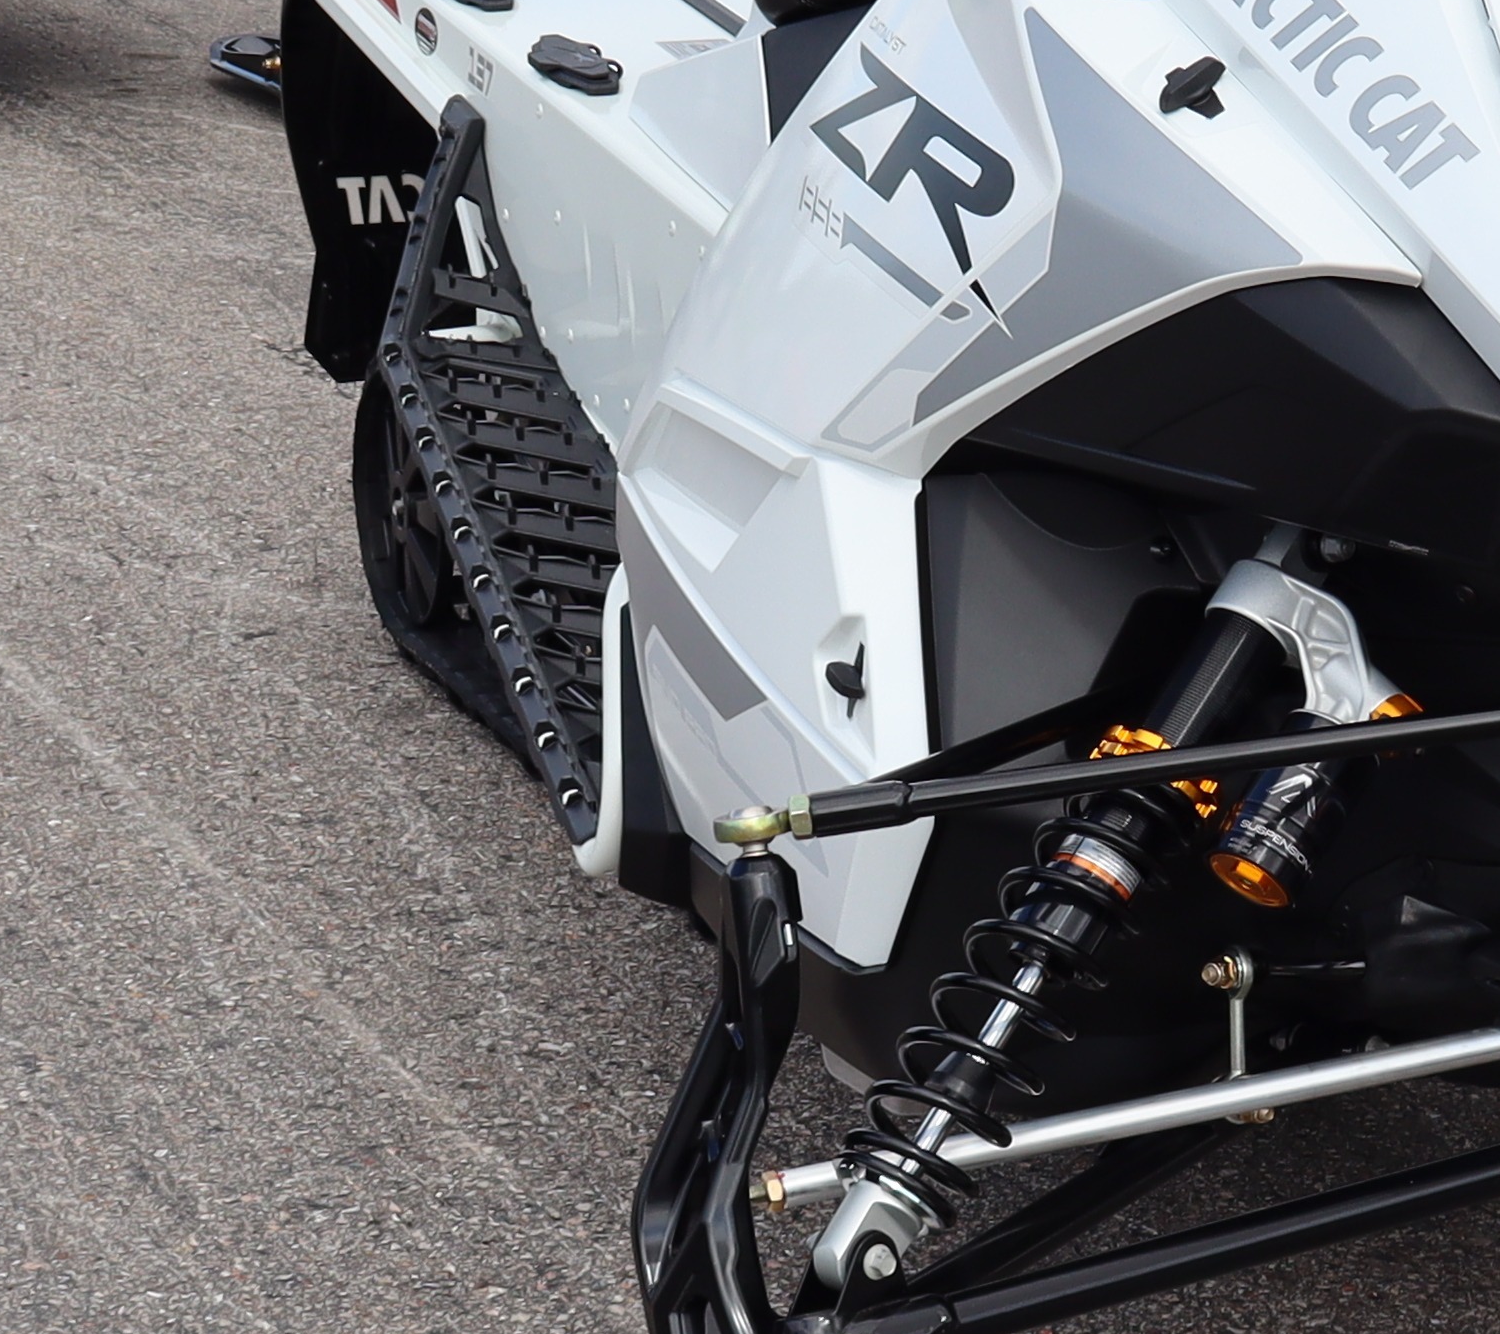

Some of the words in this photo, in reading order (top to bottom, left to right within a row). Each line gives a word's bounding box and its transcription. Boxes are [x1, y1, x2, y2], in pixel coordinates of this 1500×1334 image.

[809, 42, 1015, 317] ZR
[1349, 74, 1482, 190] CAT
[1240, 818, 1311, 872] SUSPENSION
